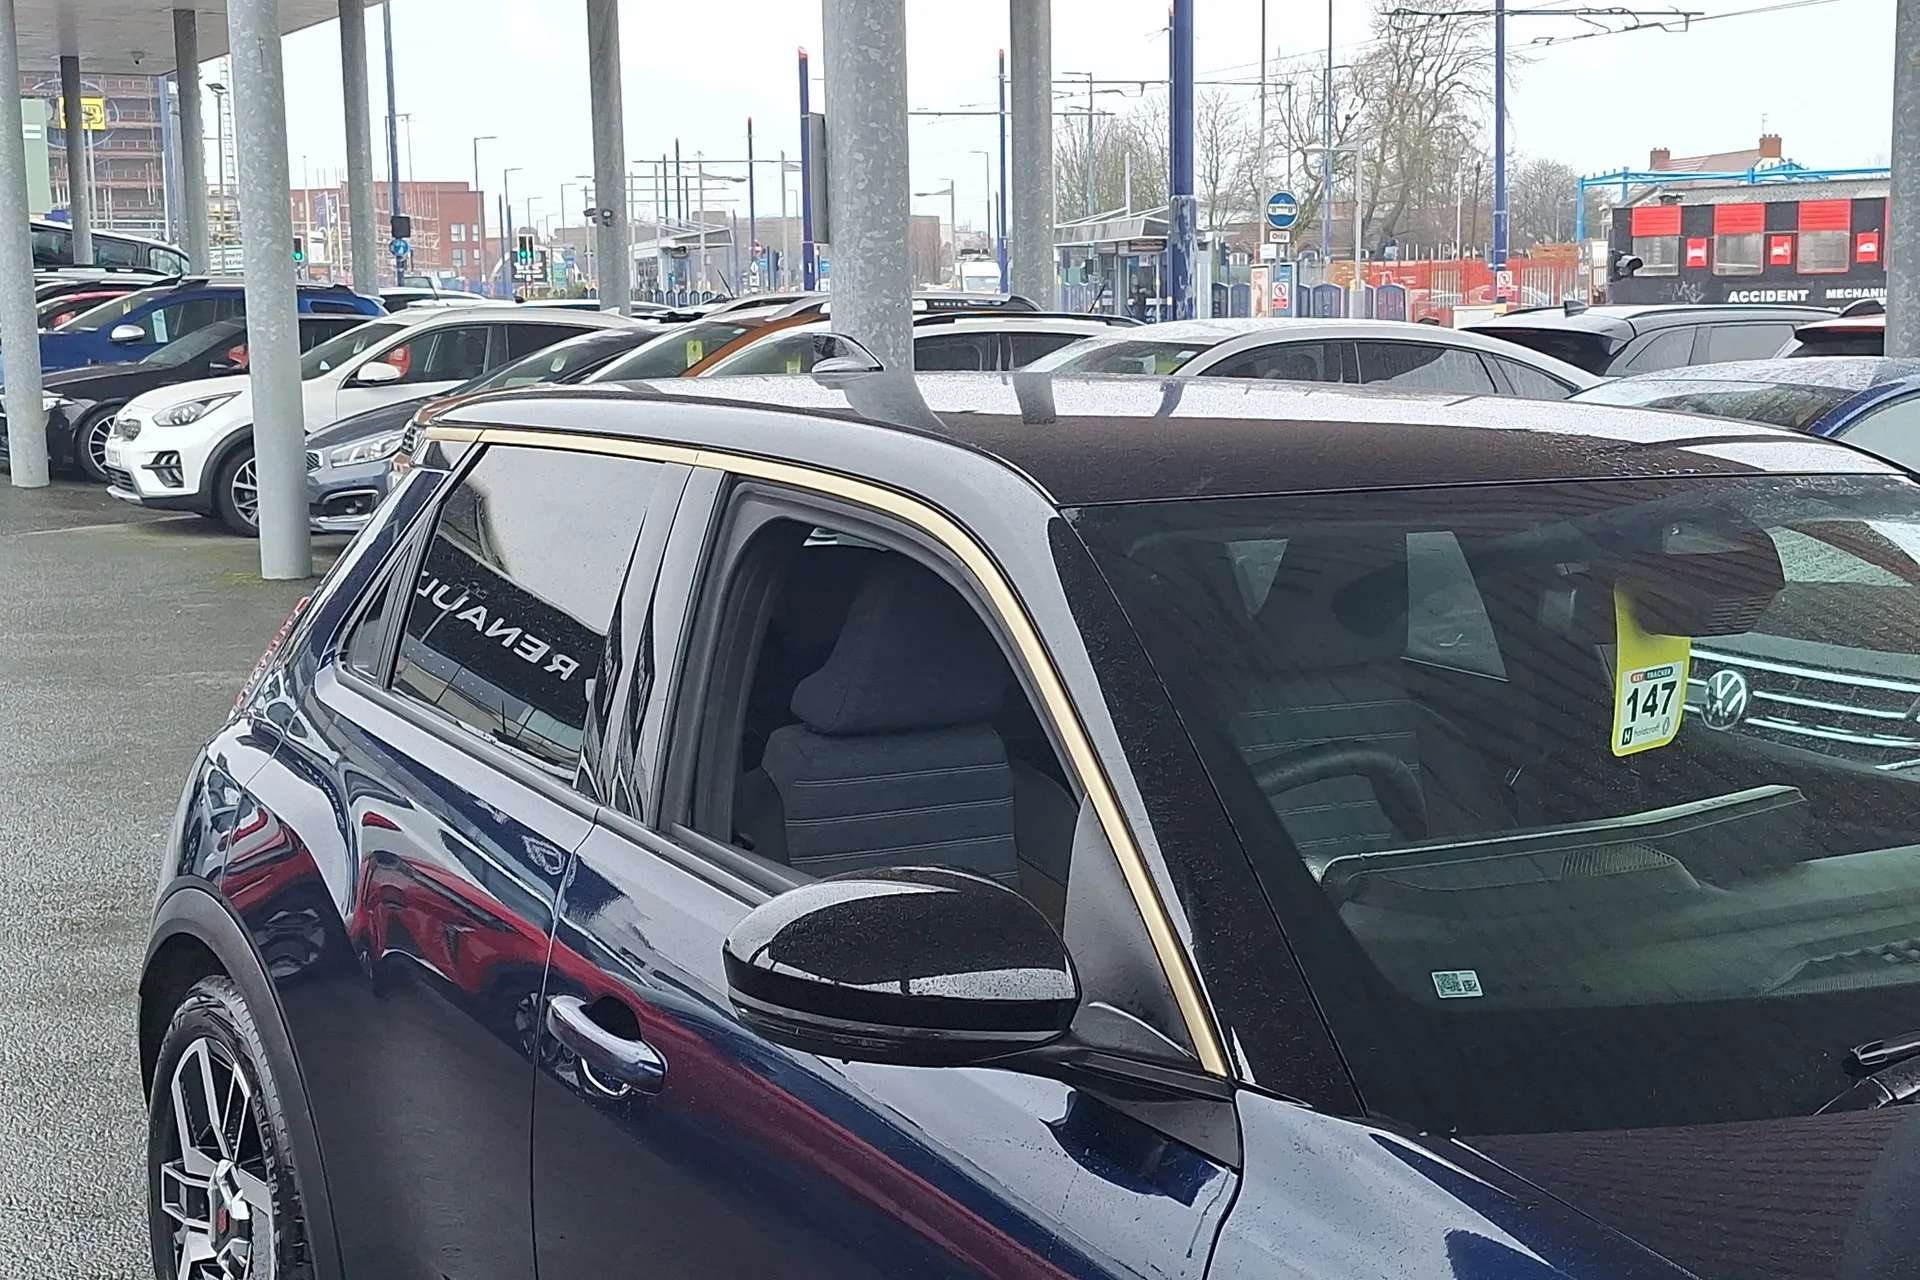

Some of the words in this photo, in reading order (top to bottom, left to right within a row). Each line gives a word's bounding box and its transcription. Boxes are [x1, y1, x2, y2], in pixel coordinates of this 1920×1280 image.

[1271, 232, 1288, 241] Only
[1728, 289, 1810, 303] ACCIDENT
[1626, 680, 1678, 723] 147
